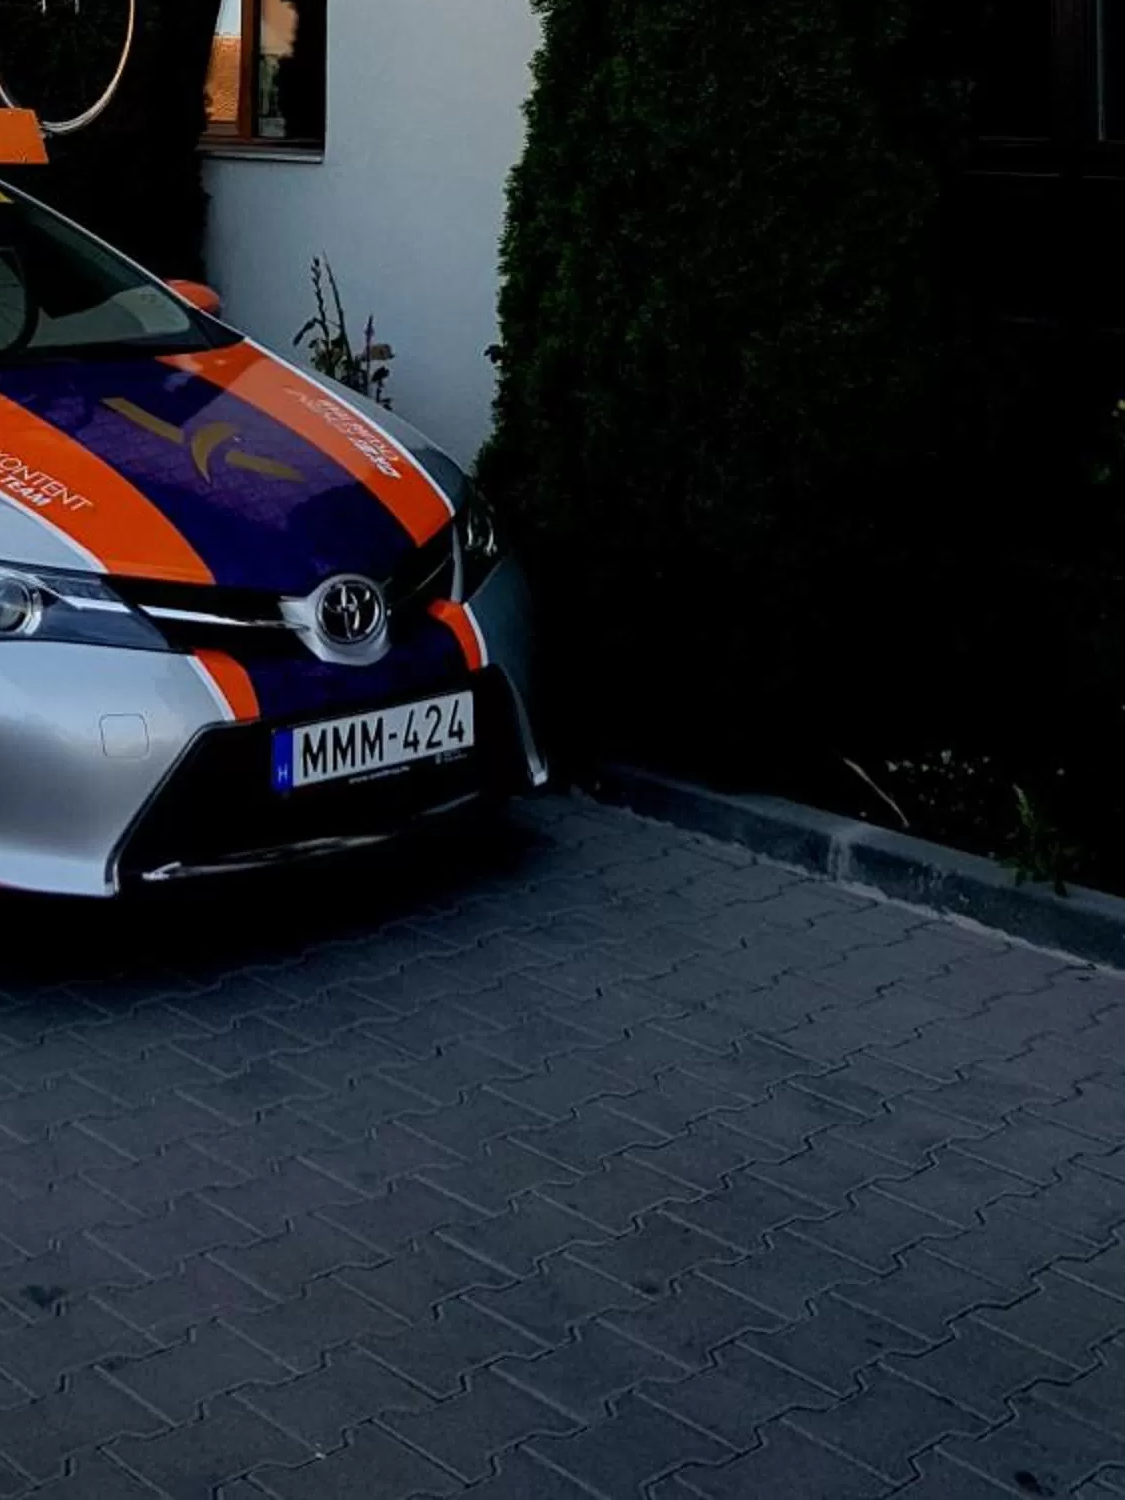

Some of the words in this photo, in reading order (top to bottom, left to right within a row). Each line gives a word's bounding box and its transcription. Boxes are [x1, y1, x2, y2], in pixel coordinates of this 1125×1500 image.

[0, 475, 53, 507] TEAM
[302, 698, 466, 778] MMM-424
[277, 763, 289, 783] H
